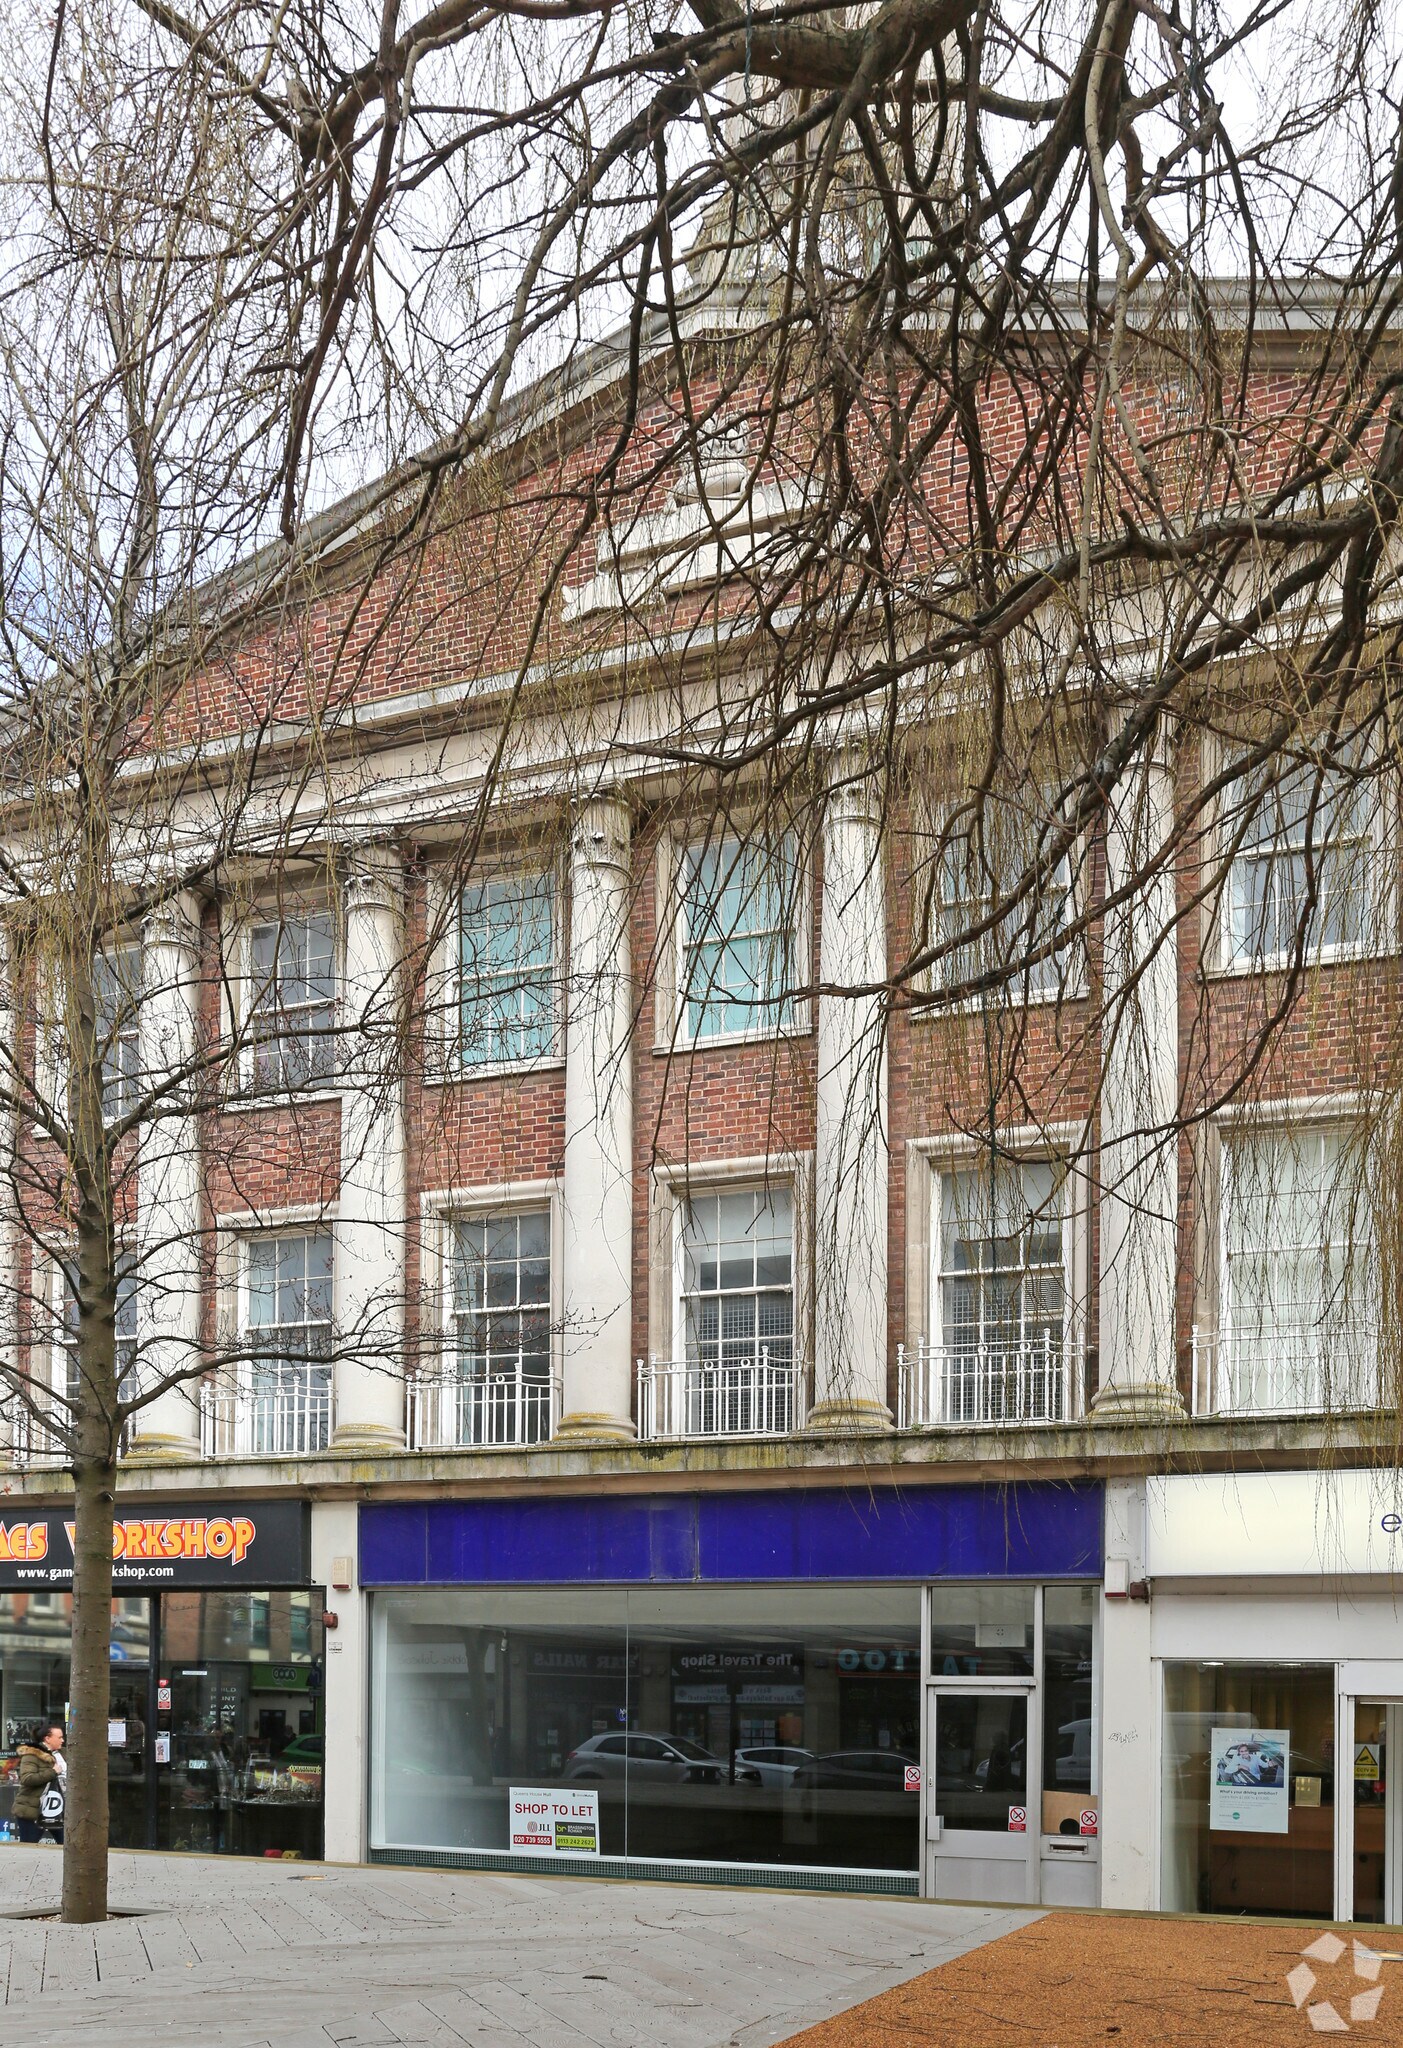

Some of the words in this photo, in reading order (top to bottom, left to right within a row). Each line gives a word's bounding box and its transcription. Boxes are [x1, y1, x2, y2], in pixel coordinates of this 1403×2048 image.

[16, 1565, 174, 1581] www.gamkshop.com
[43, 1796, 62, 1811] JD
[514, 1803, 548, 1814] SHOP
[552, 1804, 568, 1816] TO
[571, 1805, 593, 1817] LET
[538, 1823, 551, 1832] JLL
